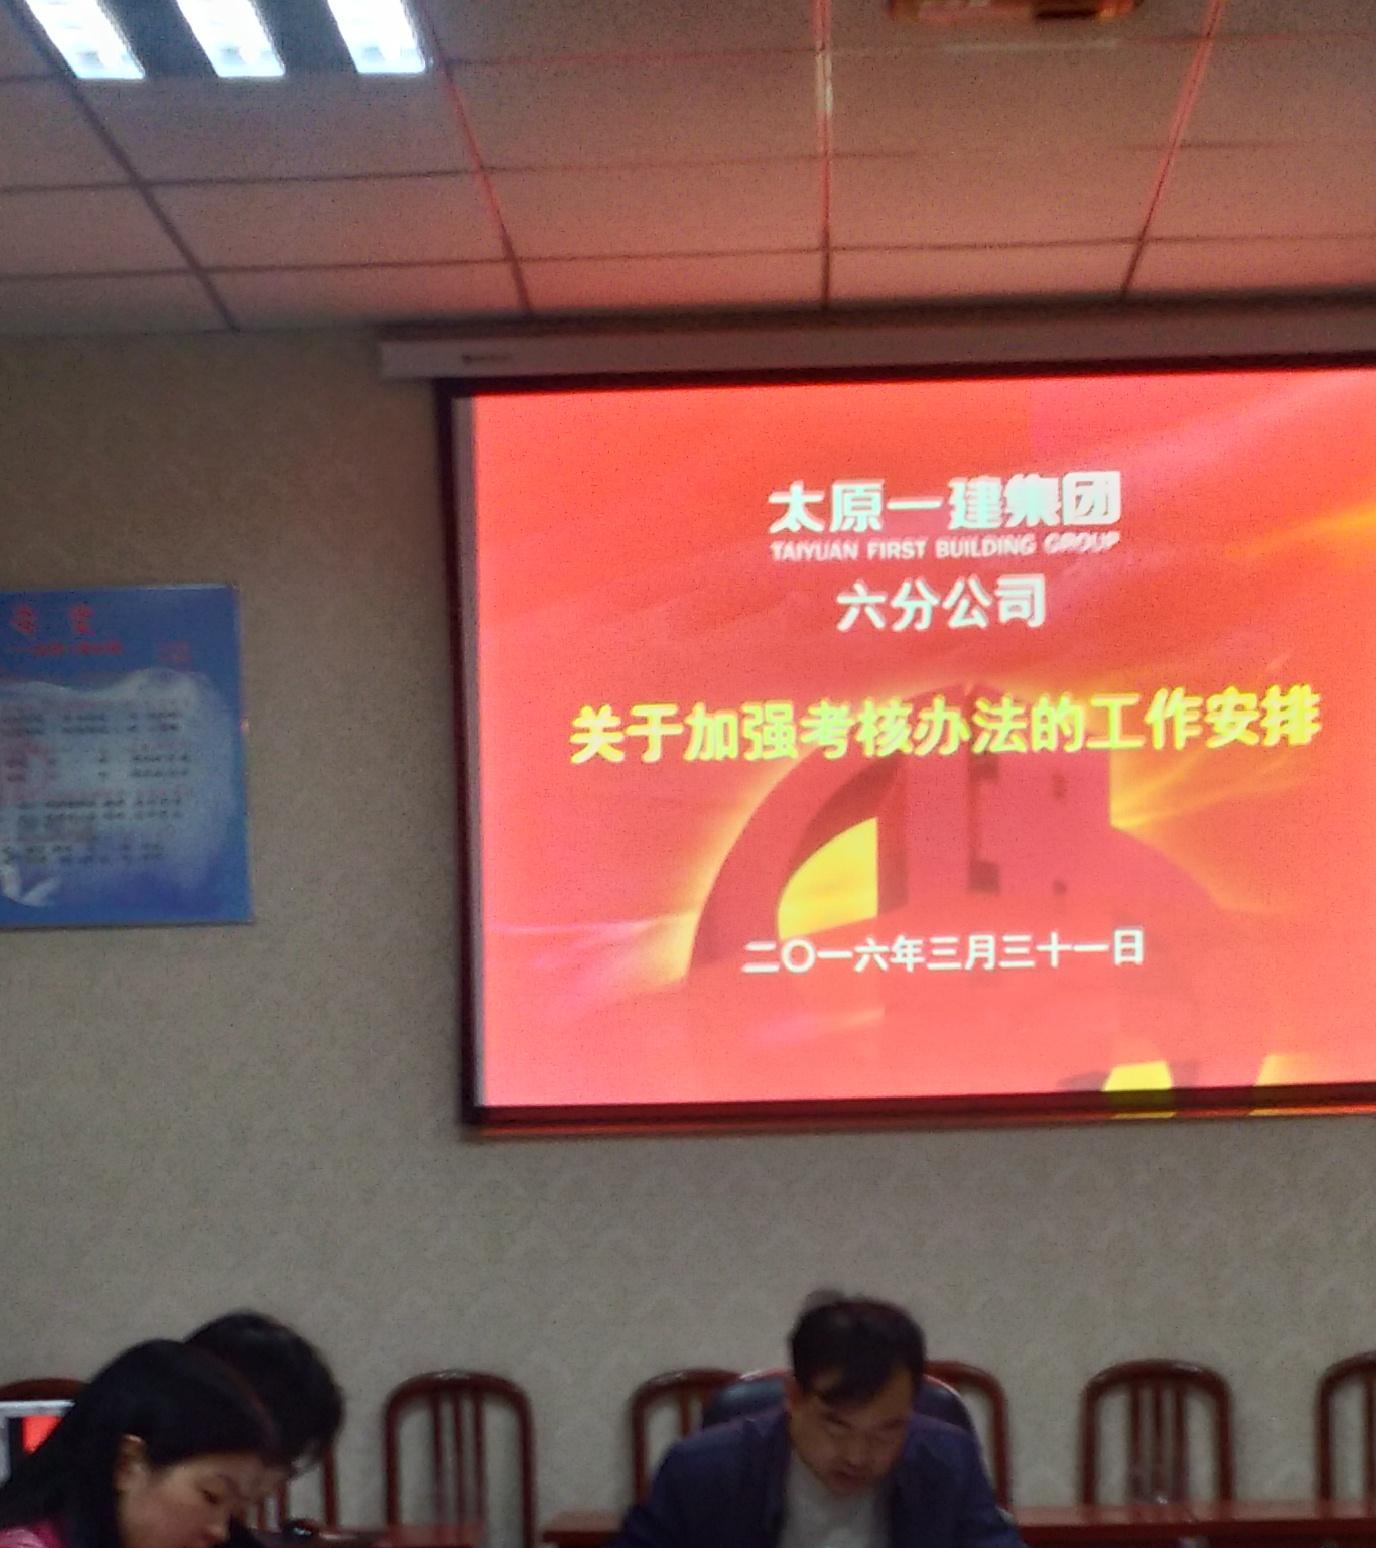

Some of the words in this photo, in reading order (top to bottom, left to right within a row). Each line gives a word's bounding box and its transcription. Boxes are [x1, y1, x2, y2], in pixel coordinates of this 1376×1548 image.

[768, 471, 1122, 533] 太原一建集团
[770, 540, 859, 561] TAIYUAN
[867, 539, 928, 560] FIRST
[935, 533, 1037, 559] BUILDING
[1043, 532, 1121, 554] GROUP
[836, 573, 1046, 632] 六分公司
[570, 684, 1322, 764] 关于加强考核办法的工作安排
